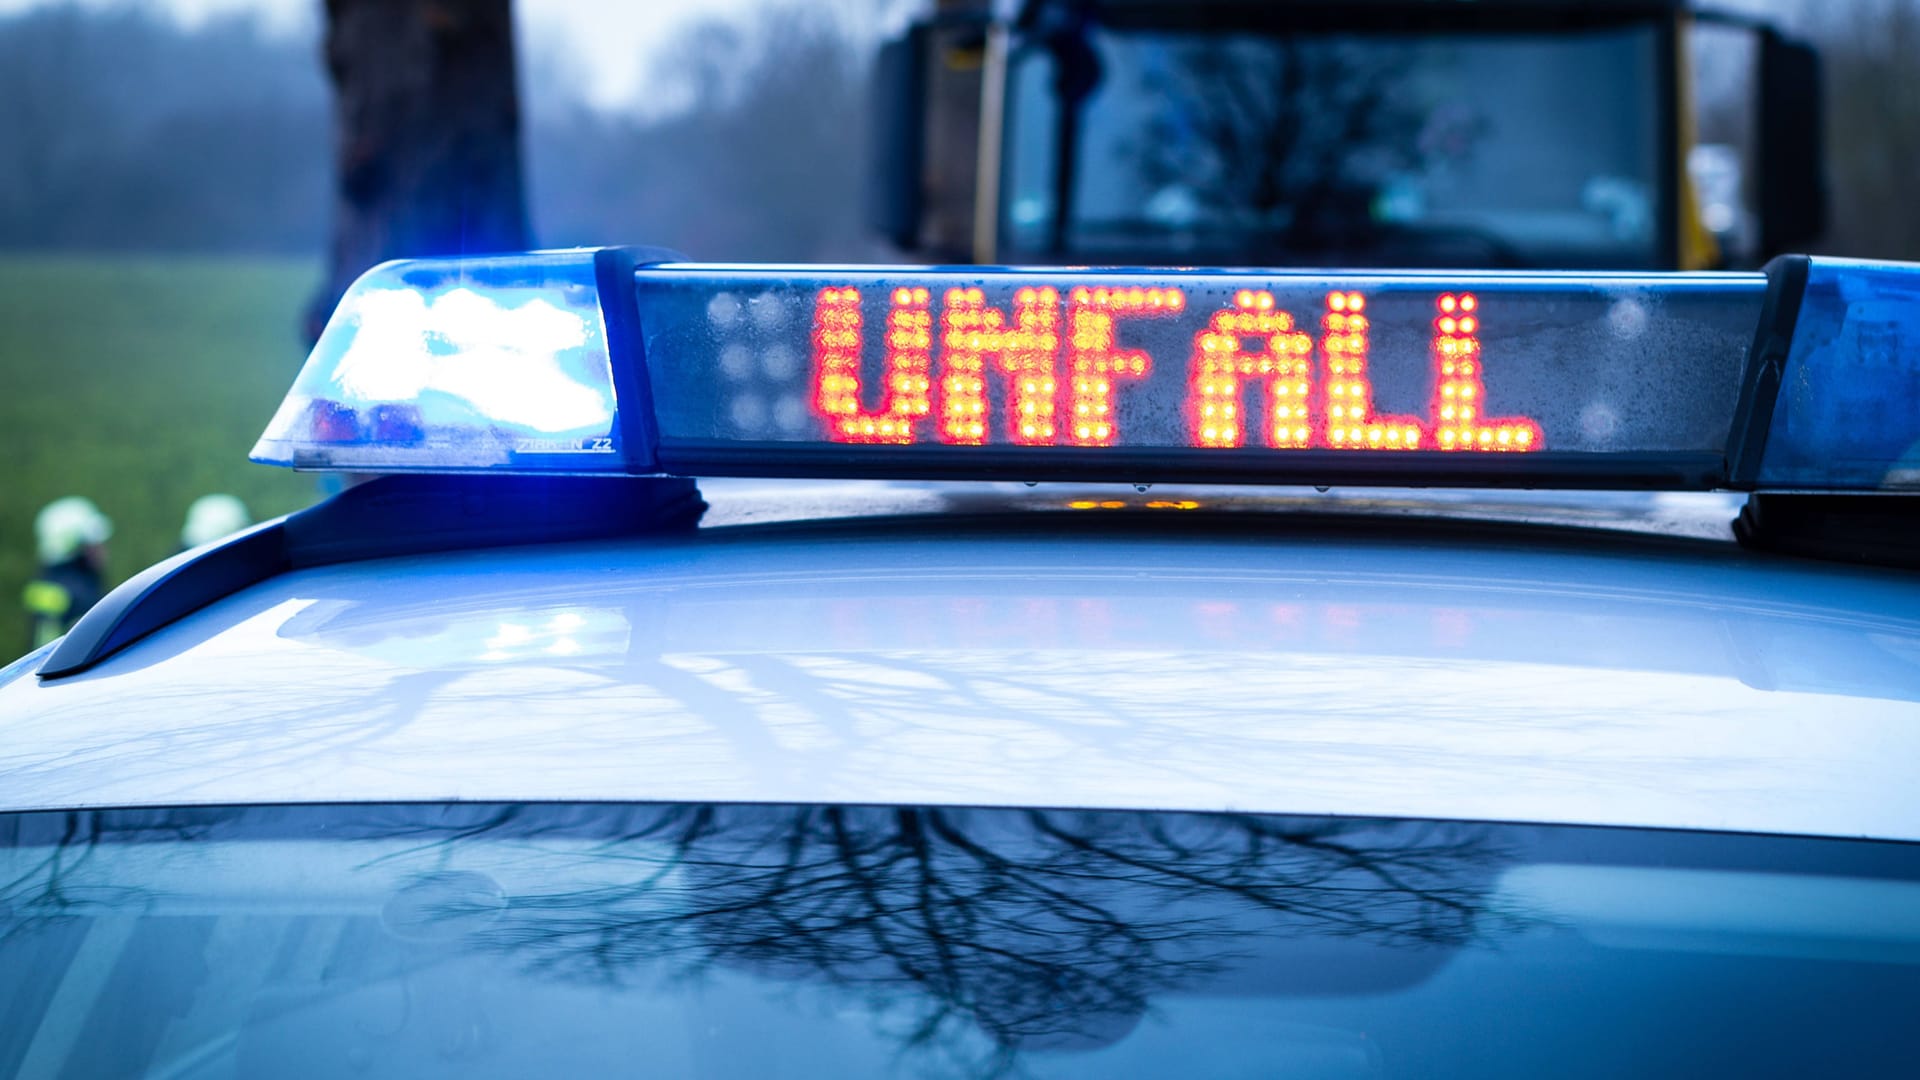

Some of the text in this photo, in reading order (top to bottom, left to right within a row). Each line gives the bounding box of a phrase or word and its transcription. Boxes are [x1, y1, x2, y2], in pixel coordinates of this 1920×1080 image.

[814, 287, 1541, 449] UNFALL
[516, 438, 612, 450] ZIRKN Z2
